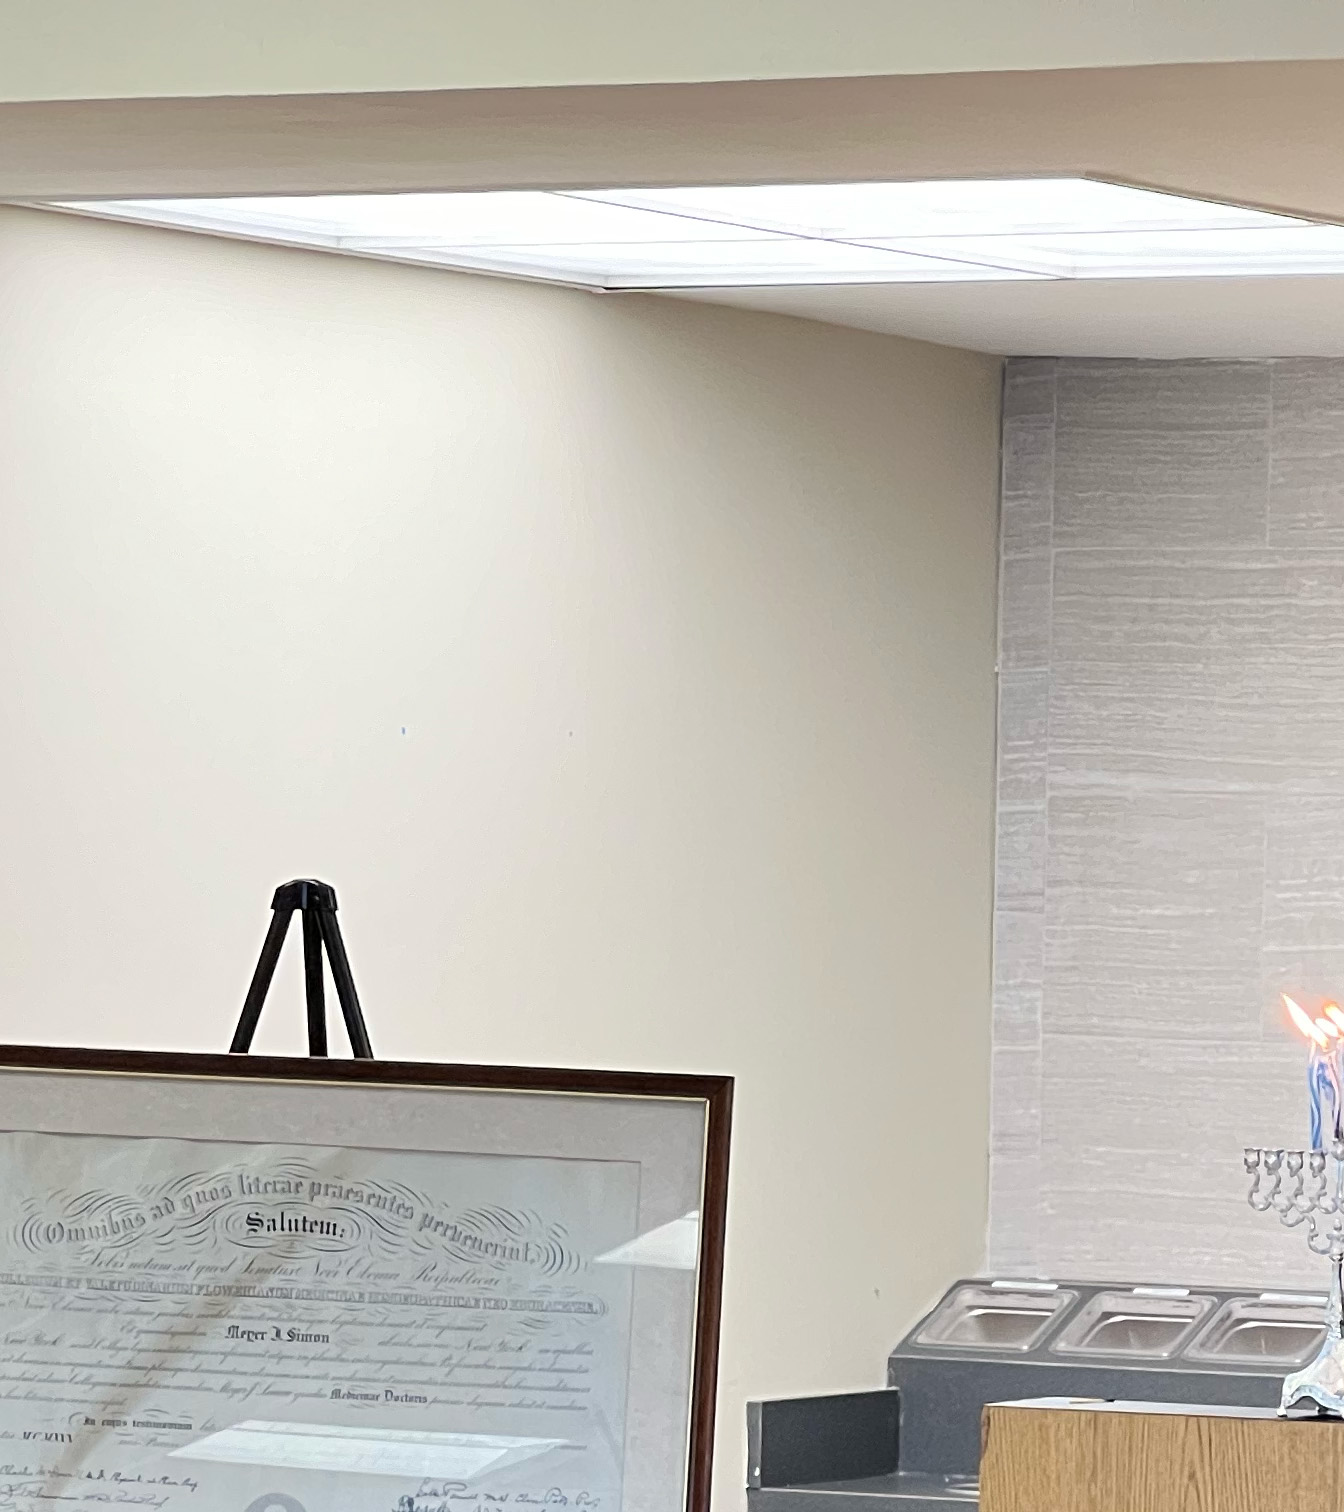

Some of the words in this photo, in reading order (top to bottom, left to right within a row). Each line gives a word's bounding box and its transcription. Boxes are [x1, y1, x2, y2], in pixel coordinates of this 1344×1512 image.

[152, 1197, 176, 1223] ad
[181, 1187, 233, 1214] quos
[285, 1326, 330, 1344] Simon
